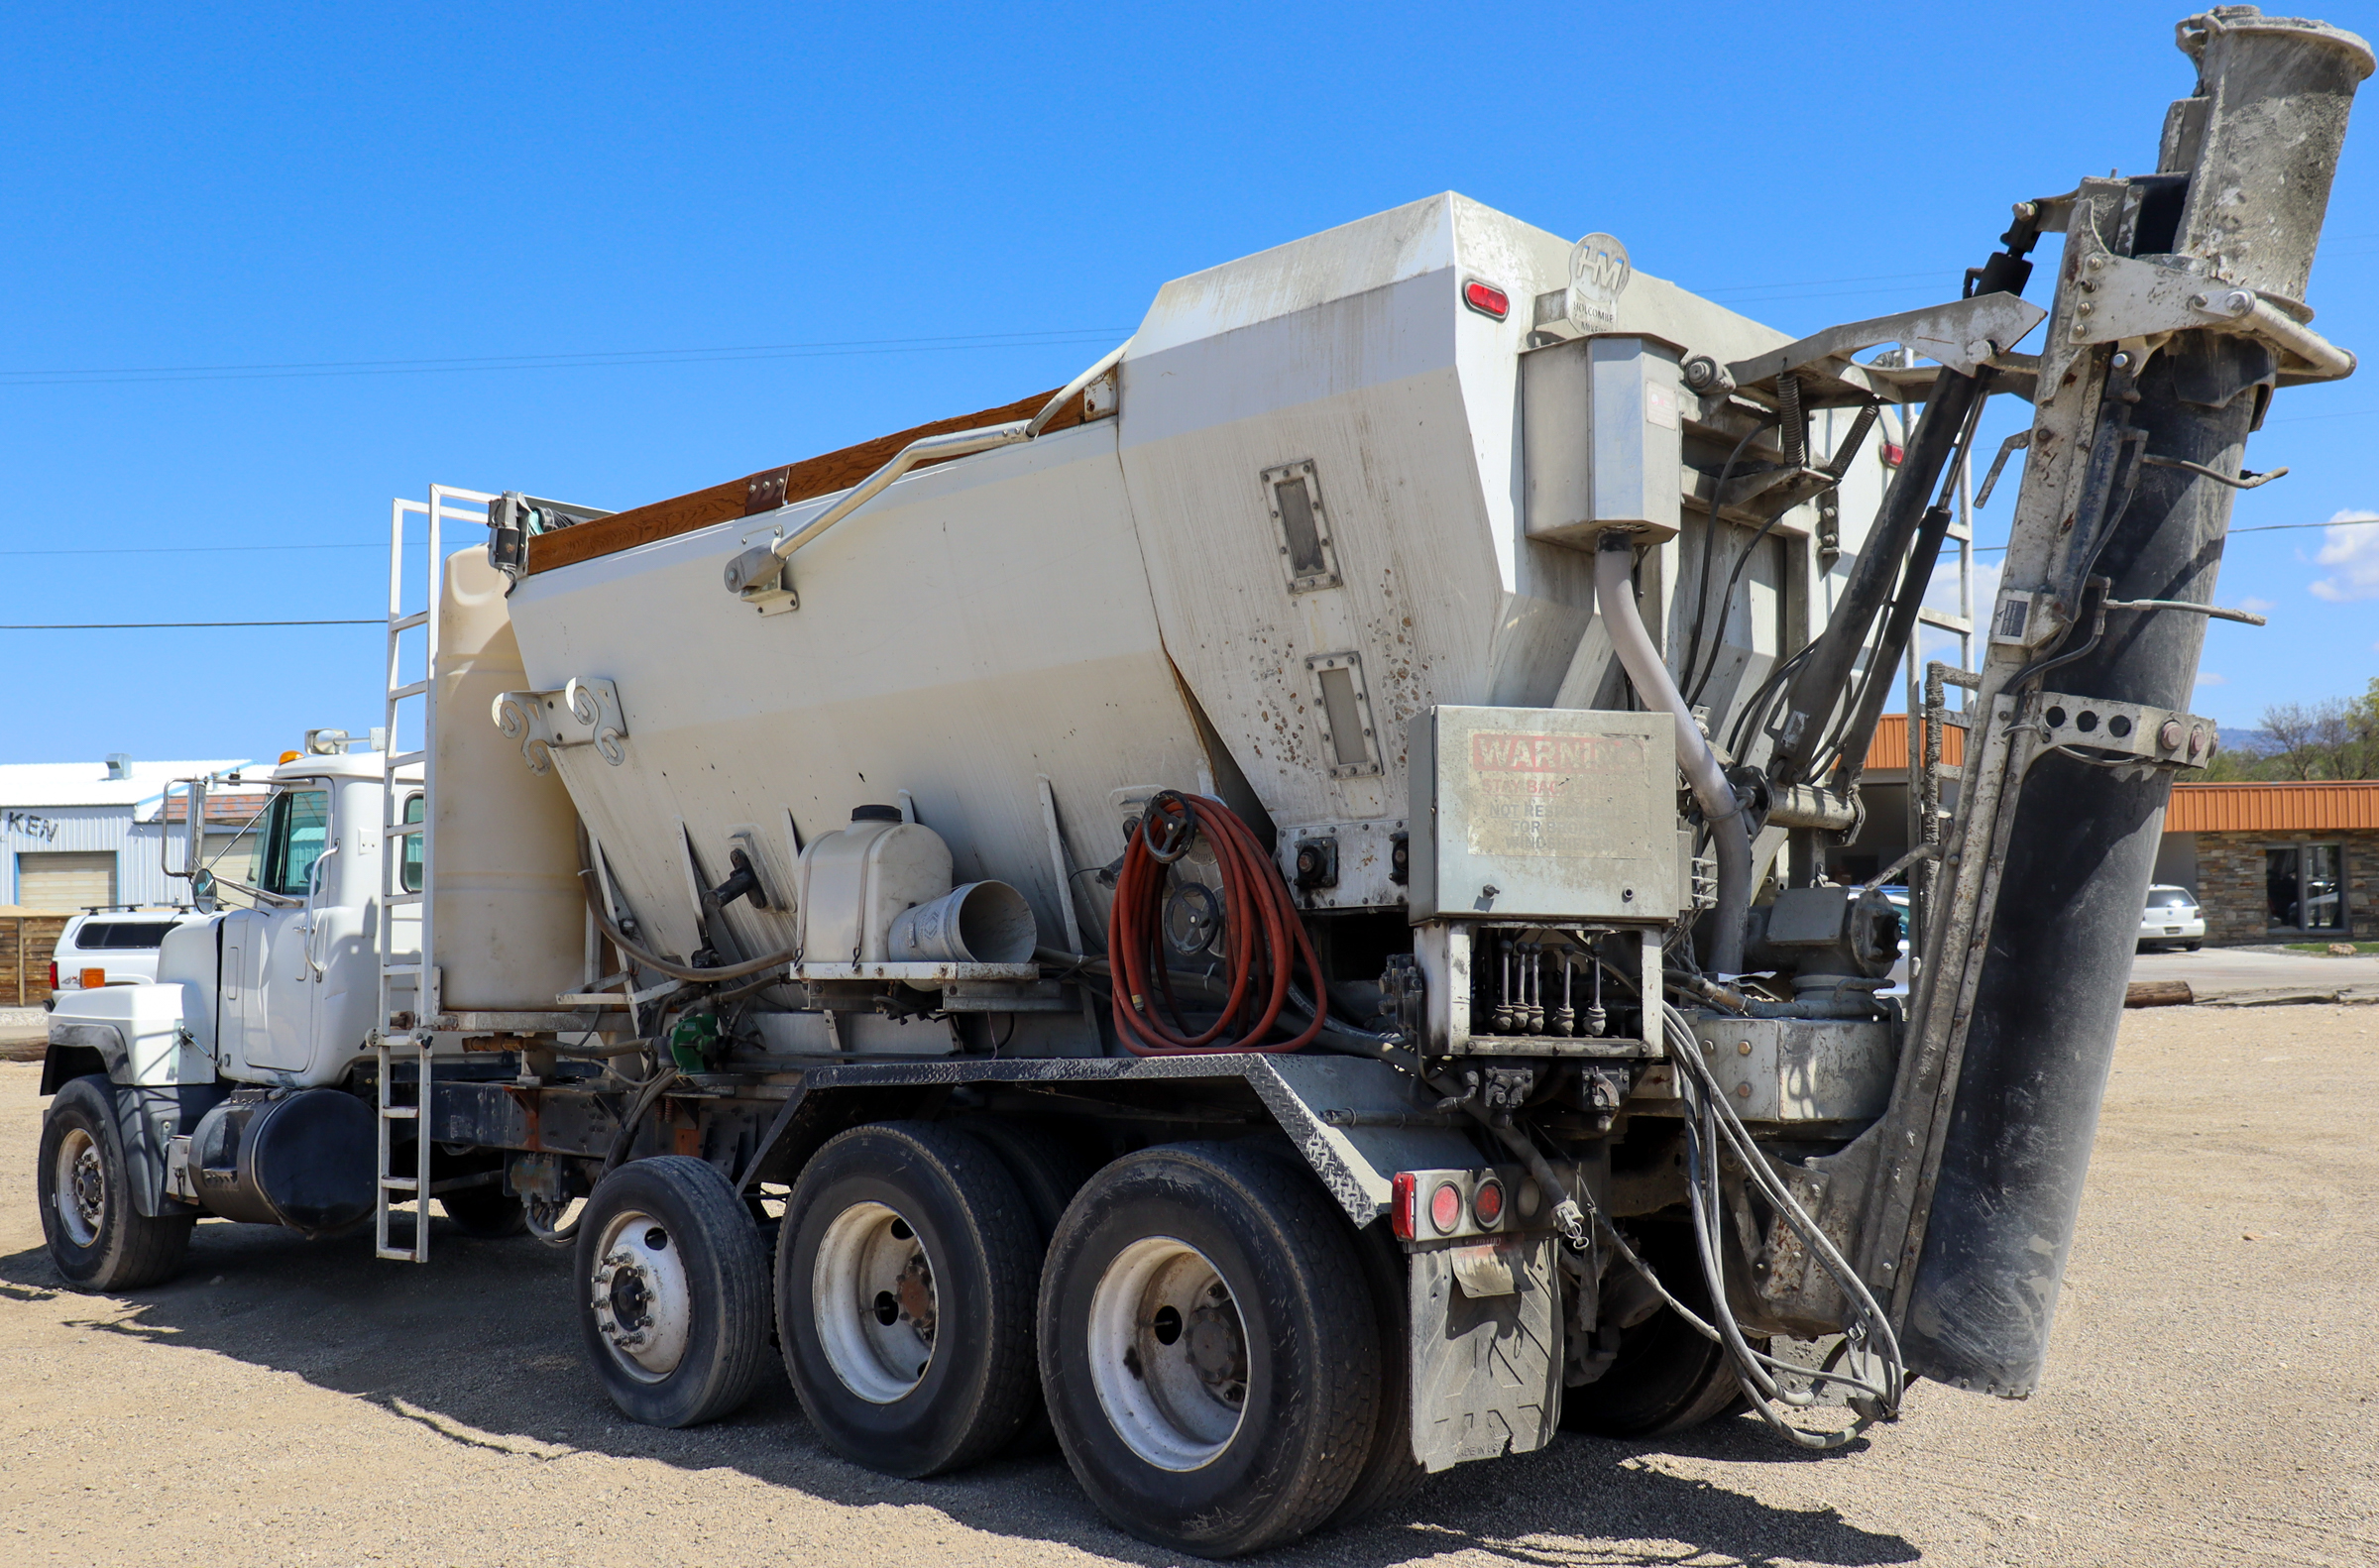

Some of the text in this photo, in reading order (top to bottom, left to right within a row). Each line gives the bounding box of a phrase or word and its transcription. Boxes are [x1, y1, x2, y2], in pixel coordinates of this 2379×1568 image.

[1574, 301, 1614, 323] HOLCOMBE
[1580, 321, 1608, 334] MIXE
[1478, 738, 1642, 771] WARNIN
[1481, 779, 1520, 794] STAY
[1489, 804, 1520, 818] NOT
[8, 812, 58, 842] KEN
[1511, 821, 1540, 834] FOR
[1476, 1237, 1502, 1247] IDAHO
